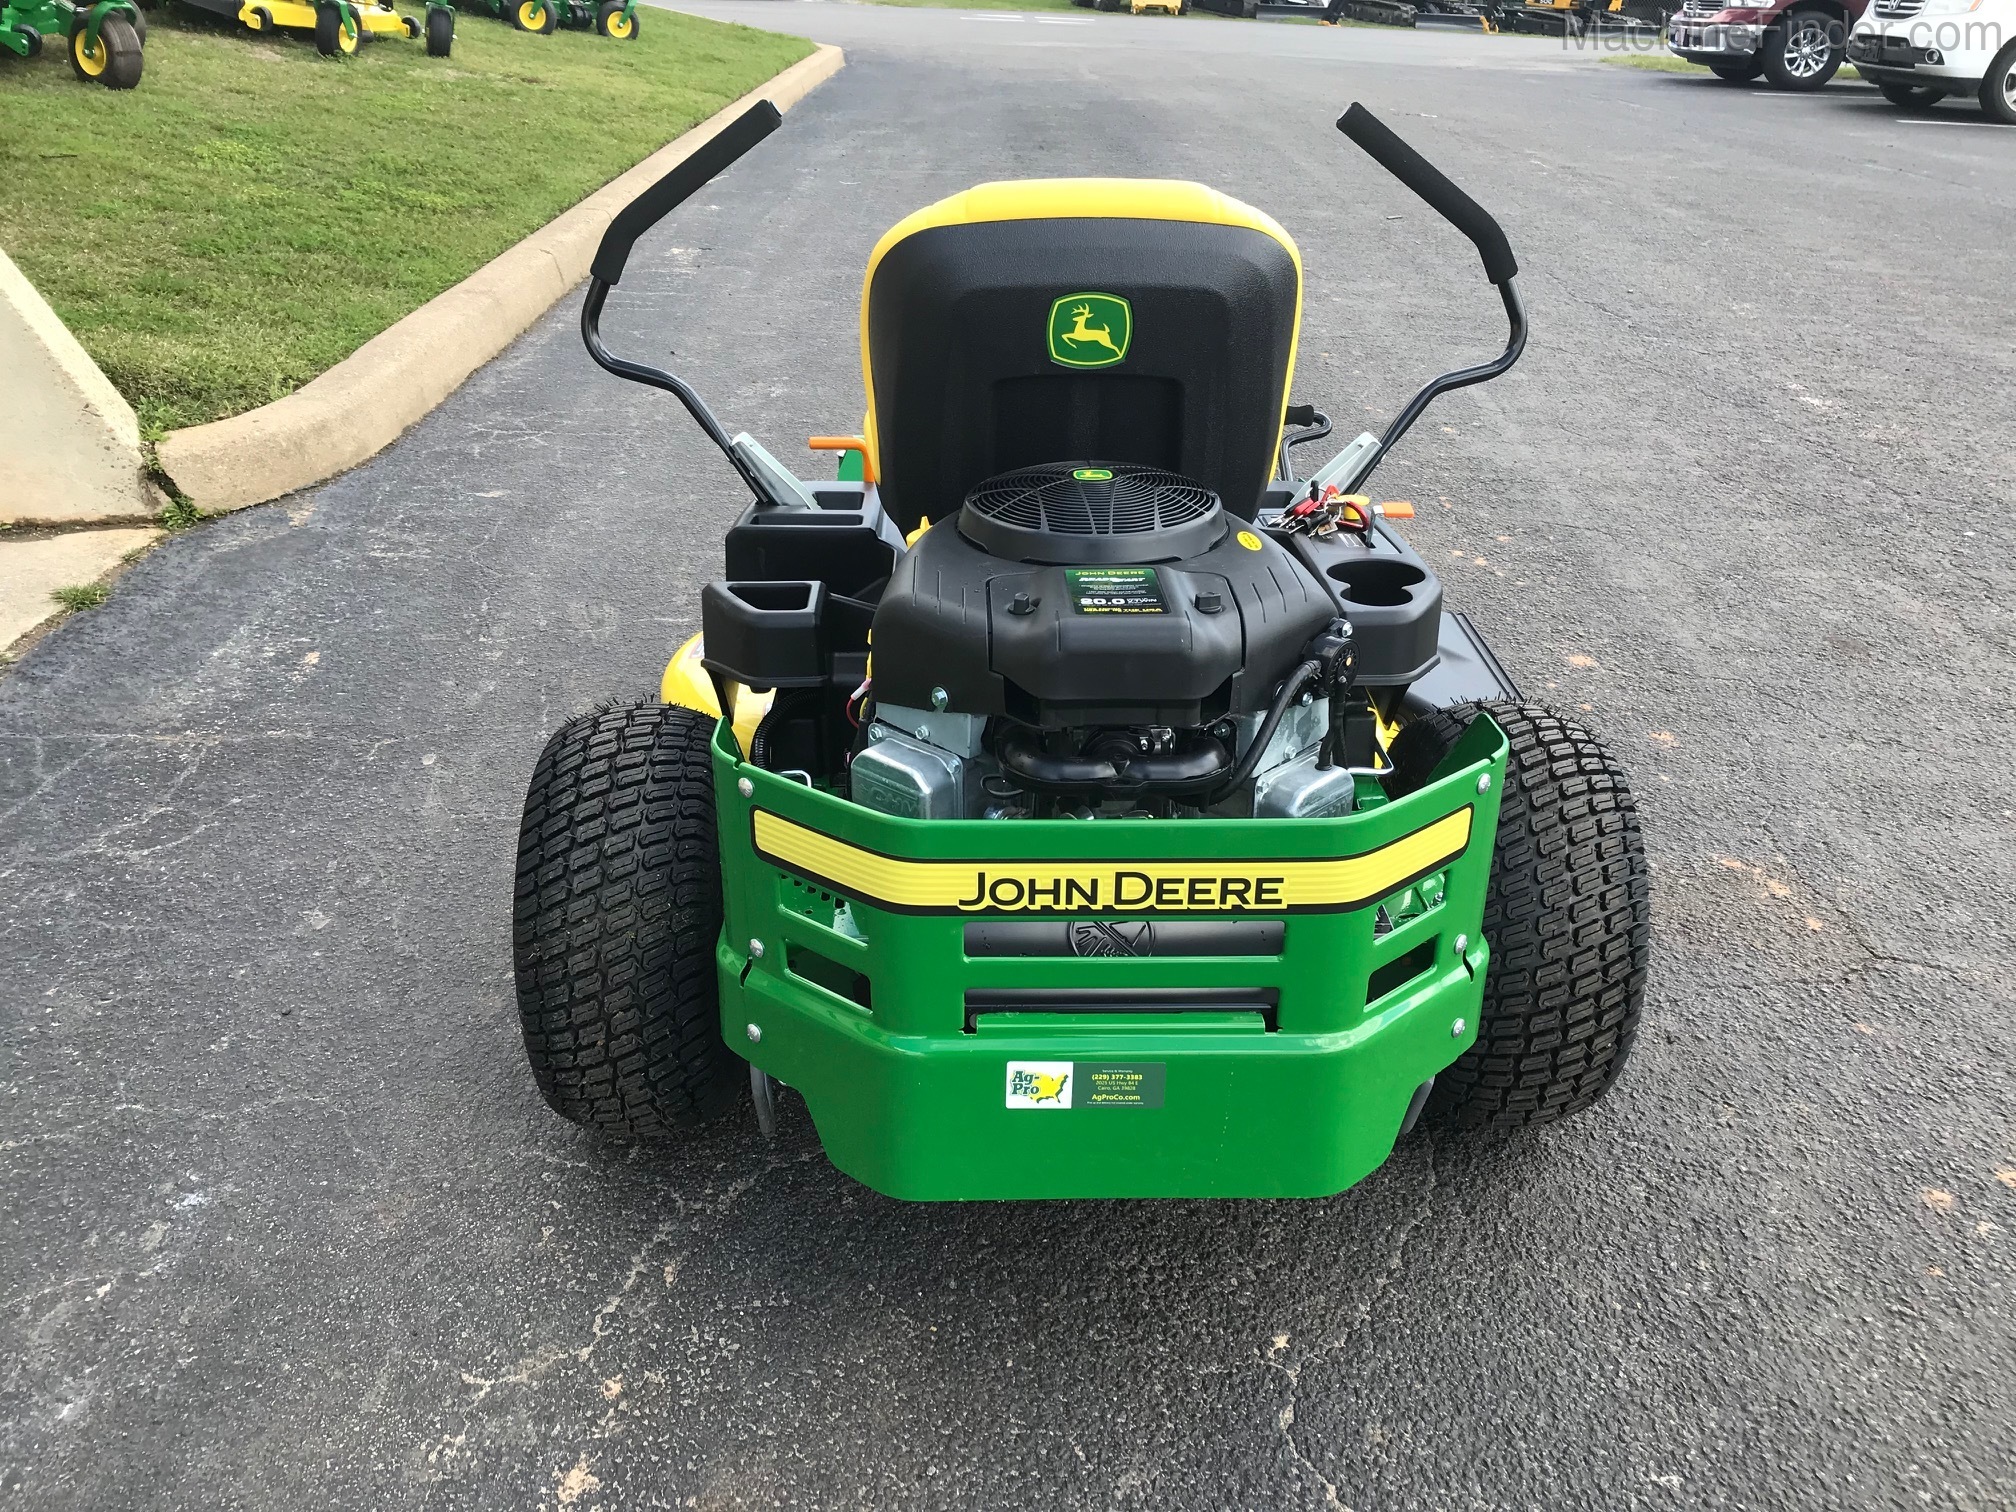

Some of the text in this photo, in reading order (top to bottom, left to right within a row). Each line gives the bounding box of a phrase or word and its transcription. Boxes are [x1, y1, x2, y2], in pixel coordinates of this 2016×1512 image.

[958, 871, 1285, 907] JOHN DEERE
[1012, 1071, 1039, 1085] Ag-
[1012, 1083, 1039, 1094] Pro
